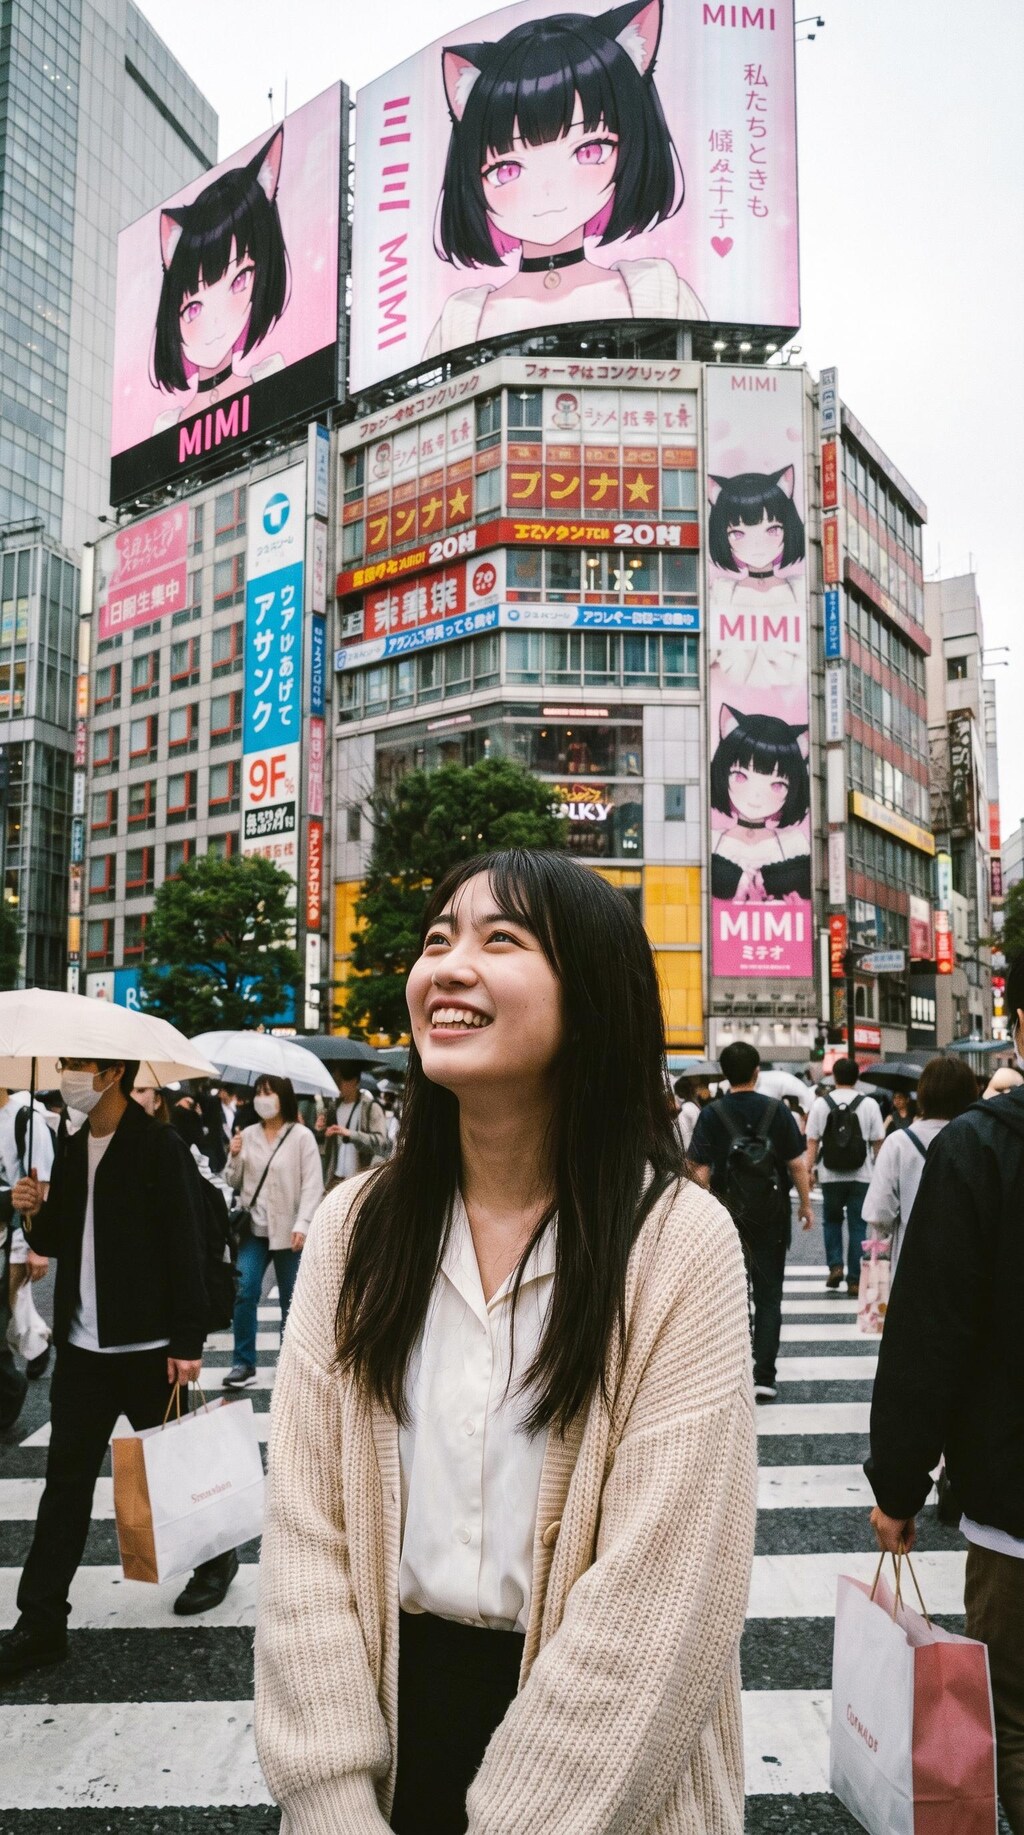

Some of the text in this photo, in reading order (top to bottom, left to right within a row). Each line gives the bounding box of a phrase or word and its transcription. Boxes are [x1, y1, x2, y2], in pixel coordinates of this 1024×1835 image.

[702, 3, 776, 31] MIMI
[743, 62, 769, 218] 私たちときも
[731, 375, 778, 392] MIMI
[178, 395, 250, 463] MIMI
[719, 613, 801, 643] MIMI
[252, 591, 275, 733] アサンク
[249, 753, 287, 802] 9F
[720, 910, 804, 942] MIMI
